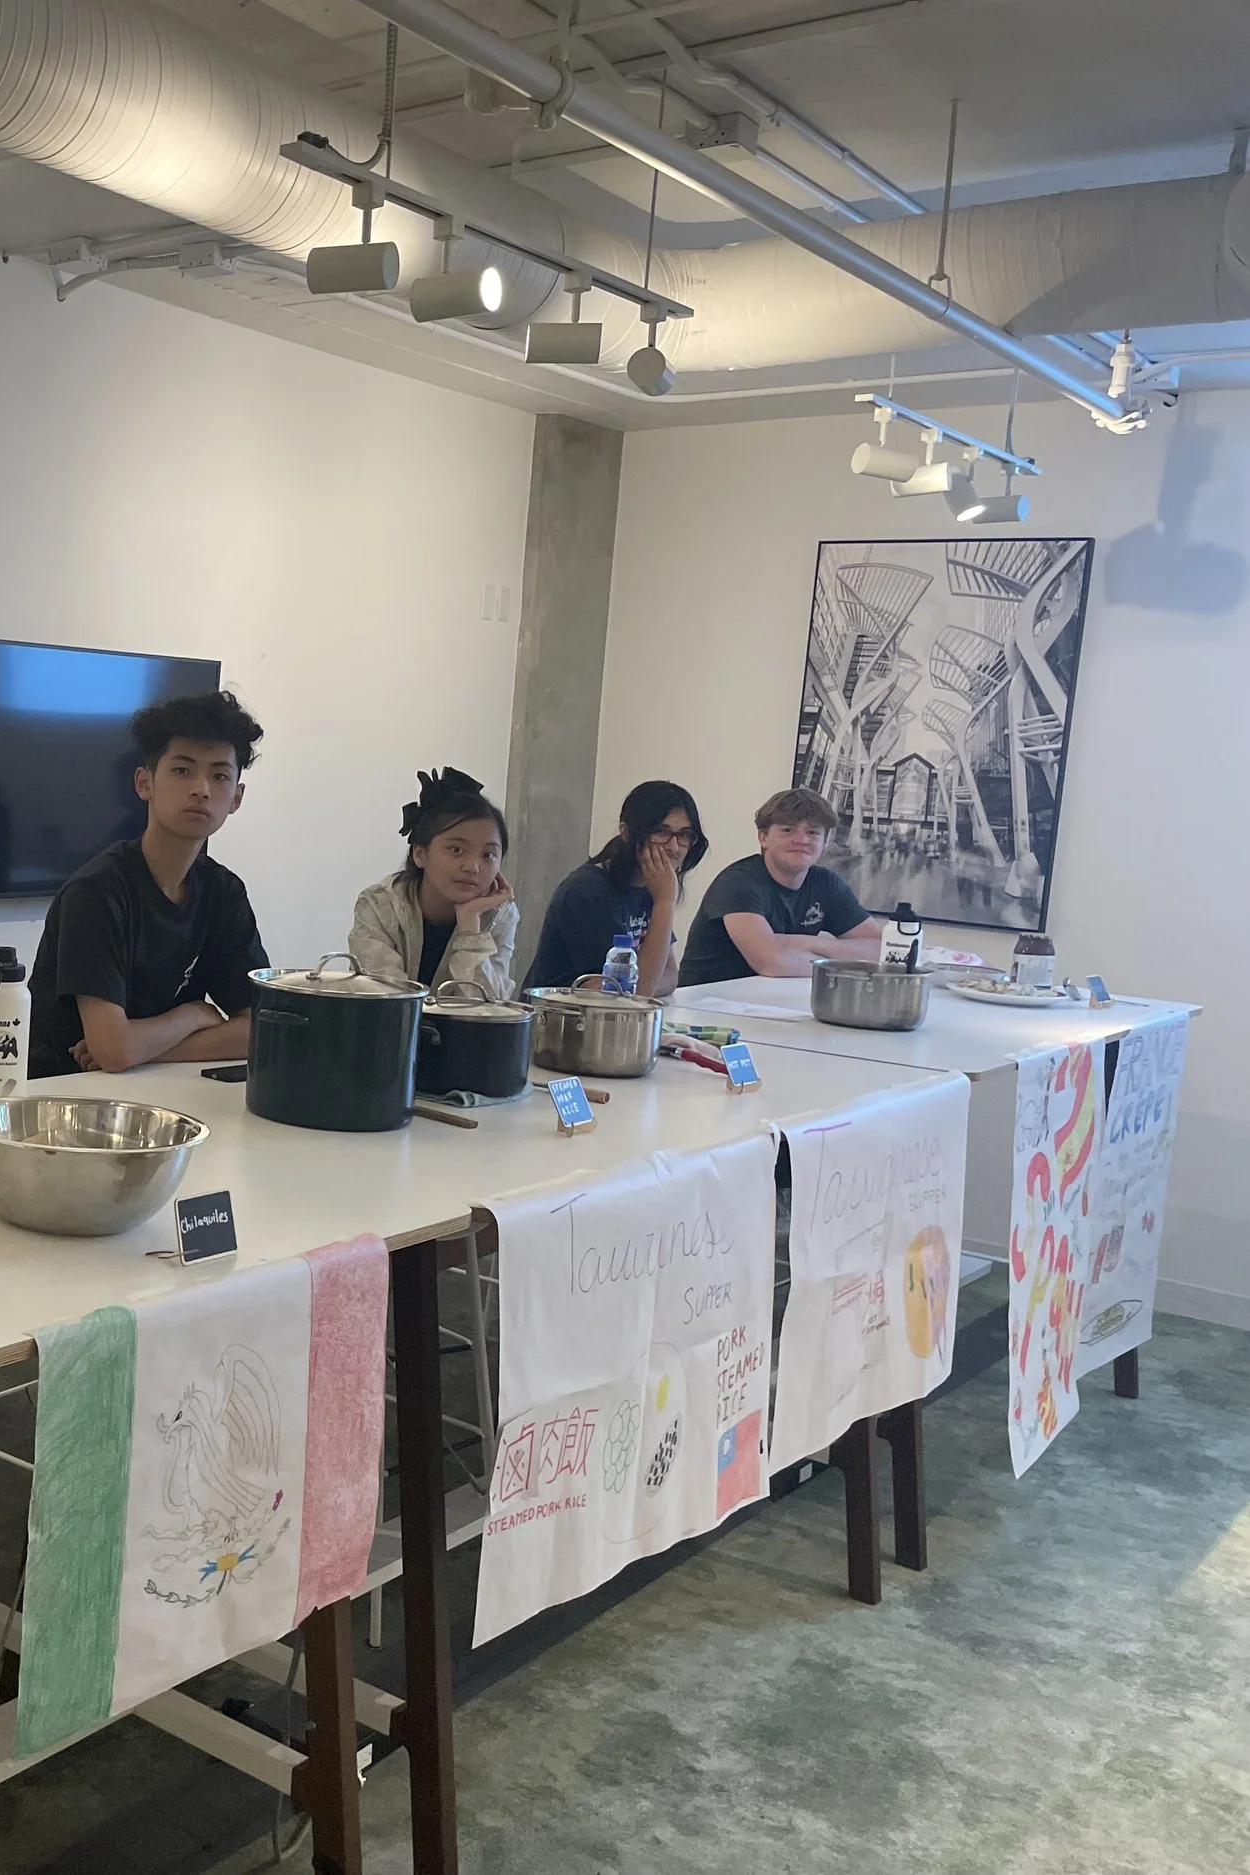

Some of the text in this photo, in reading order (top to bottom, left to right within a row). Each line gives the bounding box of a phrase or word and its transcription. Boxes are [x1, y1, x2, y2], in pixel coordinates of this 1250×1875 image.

[180, 1208, 229, 1234] Chilaquiles
[683, 1282, 732, 1325] SUPPER
[717, 1325, 746, 1367] PORK
[717, 1342, 765, 1399] STEAMED
[487, 1494, 587, 1536] STEAMED PORK RICE
